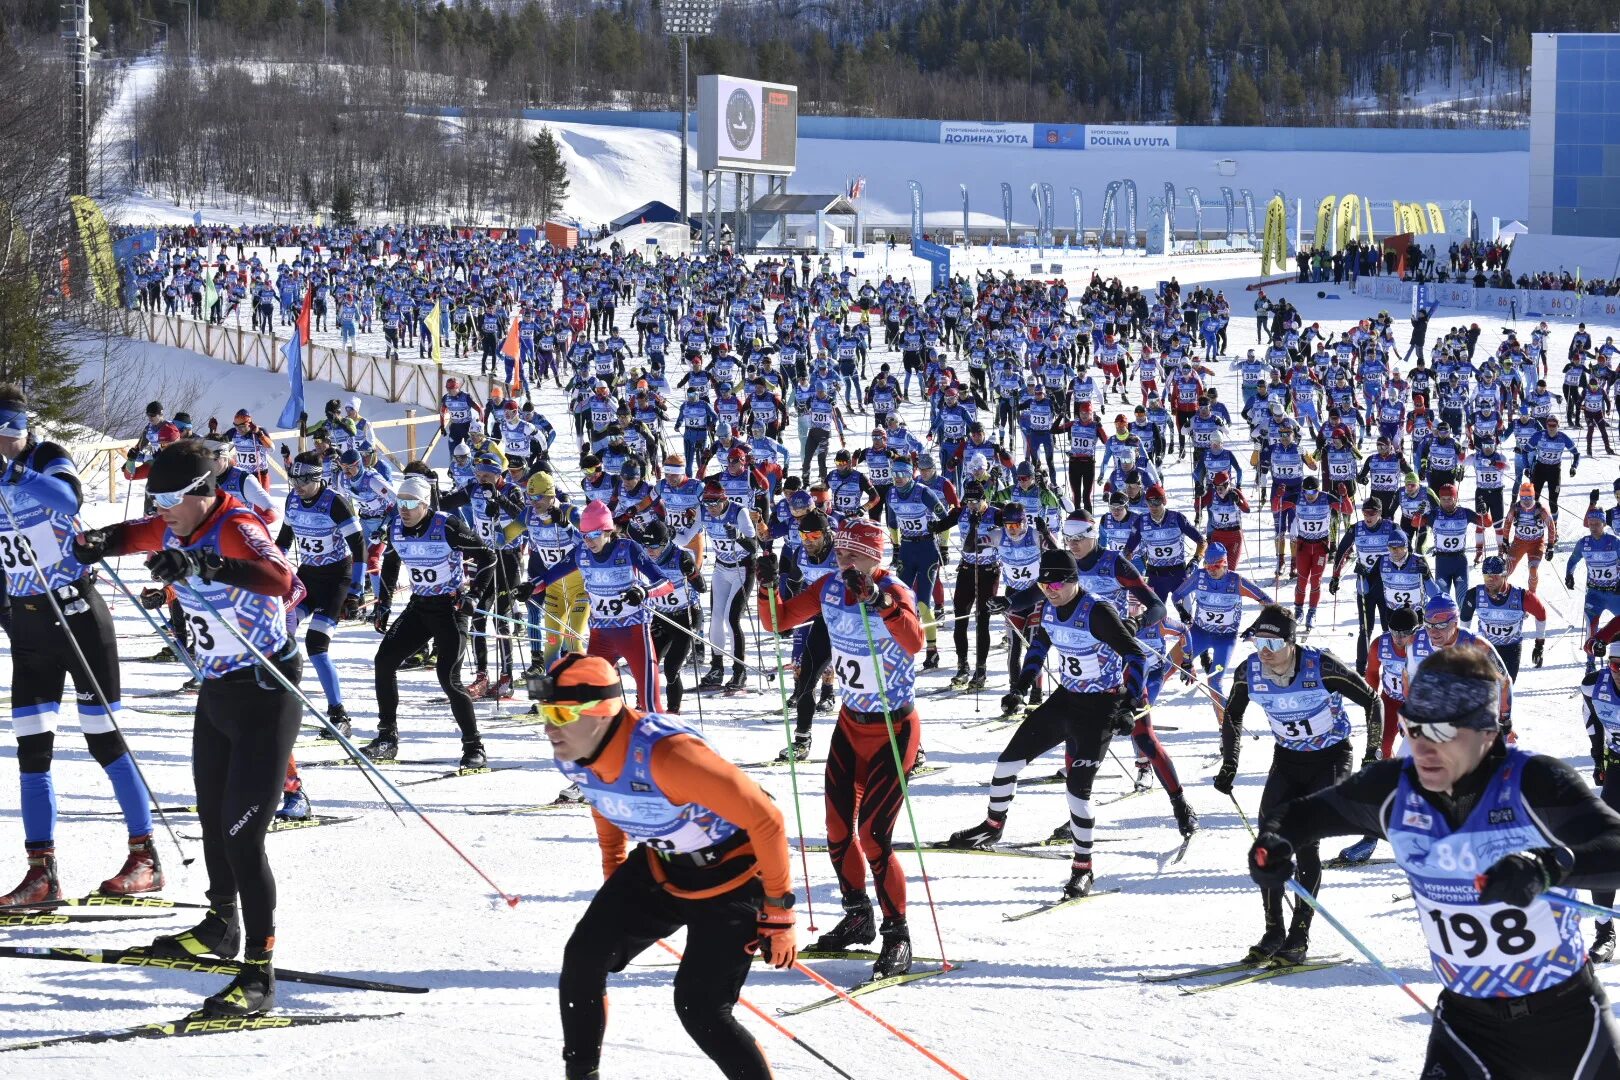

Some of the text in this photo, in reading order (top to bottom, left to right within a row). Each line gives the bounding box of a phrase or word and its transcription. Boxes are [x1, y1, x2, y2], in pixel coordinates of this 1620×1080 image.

[945, 133, 1028, 143] ДОЛИНА УЮТА
[1090, 136, 1170, 147] DOLINA UYUTA
[592, 412, 608, 421] 128
[689, 418, 700, 426] 82
[722, 414, 732, 422] 79
[814, 413, 827, 422] 201
[1033, 416, 1046, 425] 213
[1074, 439, 1089, 448] 510
[237, 452, 257, 464] 178
[1432, 456, 1450, 466] 342
[871, 468, 889, 478] 238
[1277, 467, 1293, 475] 112
[1332, 465, 1348, 474] 163
[1373, 474, 1393, 483] 254
[1480, 473, 1498, 482] 185
[1217, 513, 1230, 523] 73
[1302, 520, 1323, 532] 137
[1518, 525, 1537, 535] 206
[1443, 537, 1459, 549] 69
[540, 548, 566, 562] 157
[1154, 547, 1173, 558] 89
[1011, 567, 1032, 579] 34
[1590, 568, 1613, 579] 176
[1394, 592, 1412, 604] 62
[596, 598, 624, 616] 49
[1206, 612, 1225, 624] 92
[1485, 623, 1514, 637] 109
[835, 655, 865, 689] 42
[1278, 697, 1299, 709] 86
[1281, 719, 1314, 737] 31
[602, 796, 632, 818] 86
[228, 809, 252, 837] CRAFT
[276, 819, 320, 832] FISCHER
[1436, 842, 1478, 872] 86
[86, 897, 175, 908] FISCHER
[0, 915, 70, 926] SCHER
[1427, 908, 1537, 958] 198
[184, 1015, 293, 1033] FISCHER
